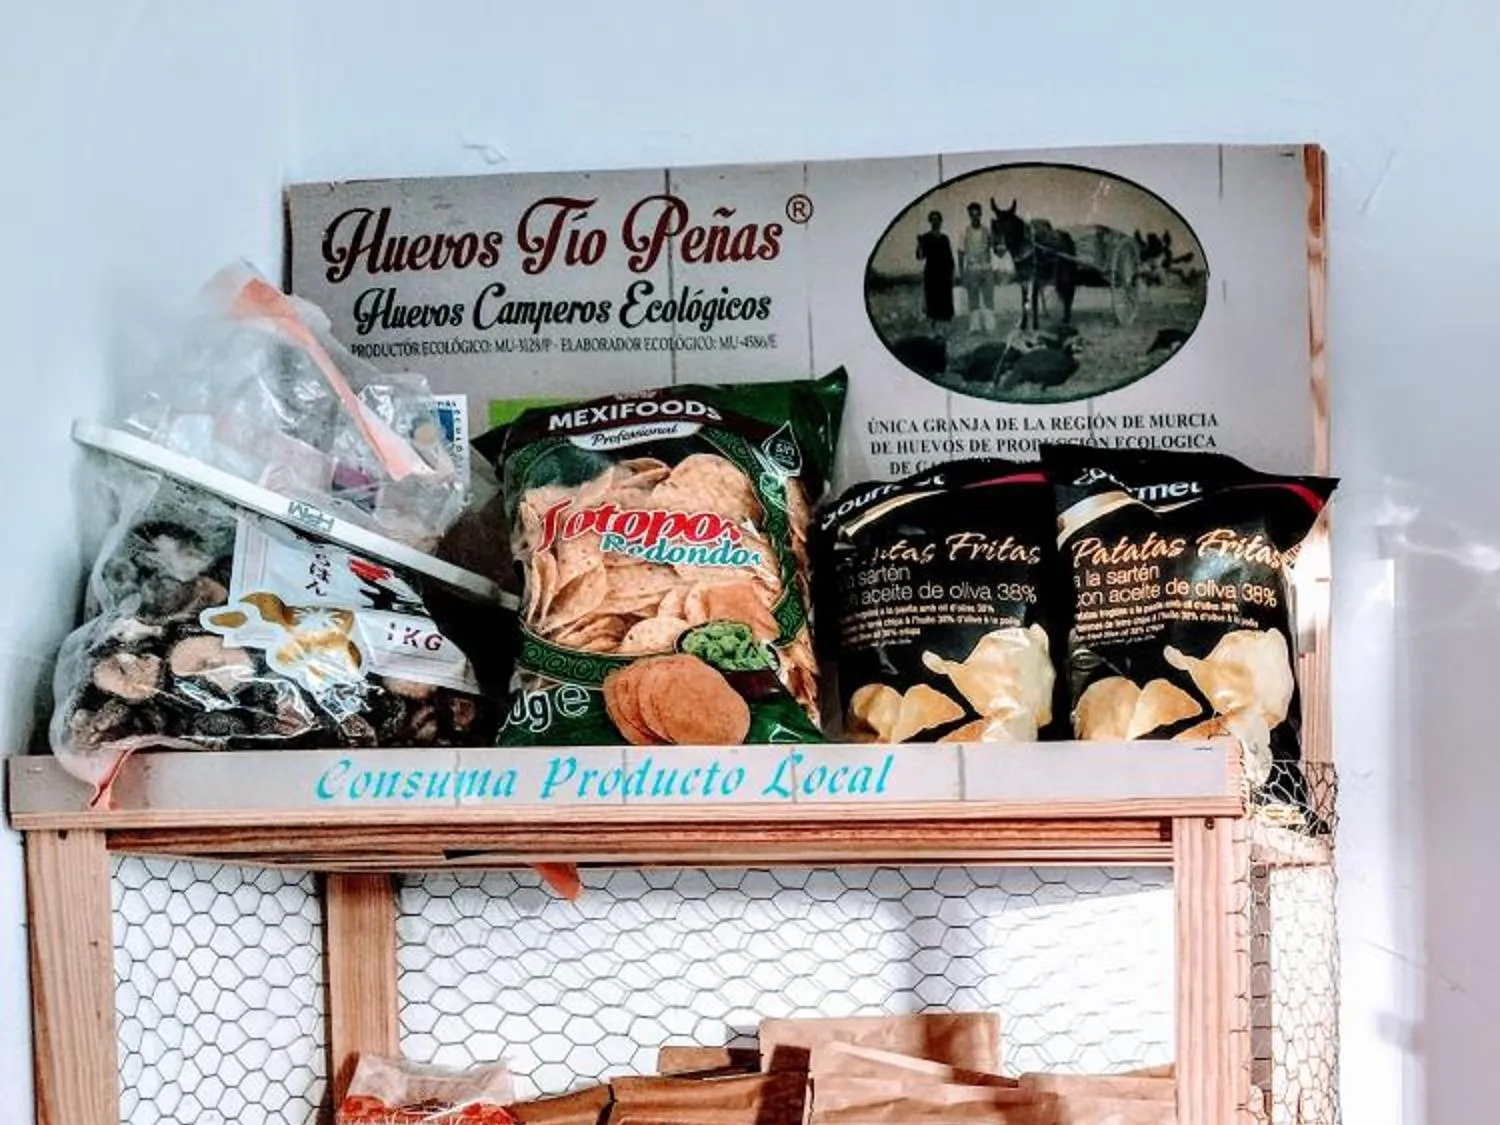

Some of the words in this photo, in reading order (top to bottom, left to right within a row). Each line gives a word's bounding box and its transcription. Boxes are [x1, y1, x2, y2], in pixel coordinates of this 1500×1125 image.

[322, 207, 502, 284] Huevos
[517, 197, 606, 275] Tío
[622, 194, 783, 273] Peñas
[353, 288, 463, 336] Huevos
[473, 283, 612, 336] Camperos
[619, 280, 771, 333] Ecológicos
[549, 400, 724, 431] MEXIFOODS
[867, 417, 919, 434] ÚNICA
[923, 417, 991, 433] GRANJA
[996, 417, 1018, 431] DE
[1023, 417, 1046, 431] LA
[1051, 412, 1117, 430] REGIÓN
[1123, 415, 1145, 429] DE
[1149, 413, 1218, 429] MURCIA
[870, 440, 893, 455] DE
[897, 438, 965, 454] HUEVOS
[969, 438, 991, 453] DE
[890, 461, 911, 475] DE
[537, 499, 745, 552] Totopos
[602, 532, 762, 566] Redondos
[945, 531, 1042, 564] Fritas
[1071, 532, 1187, 569] Patatas
[1195, 528, 1284, 569] Fritas
[857, 565, 911, 587] sartén
[1085, 570, 1101, 586] la
[1106, 565, 1160, 585] sartén
[861, 584, 913, 604] aceite
[918, 581, 943, 600] de
[949, 581, 991, 601] oliva
[996, 583, 1038, 603] 38%
[1109, 583, 1160, 604] aceite
[1165, 578, 1189, 596] de
[1195, 579, 1237, 600] oliva
[1241, 582, 1278, 608] 38%
[314, 758, 518, 801] Consuma
[540, 756, 746, 801] Producto
[760, 753, 896, 800] Local
